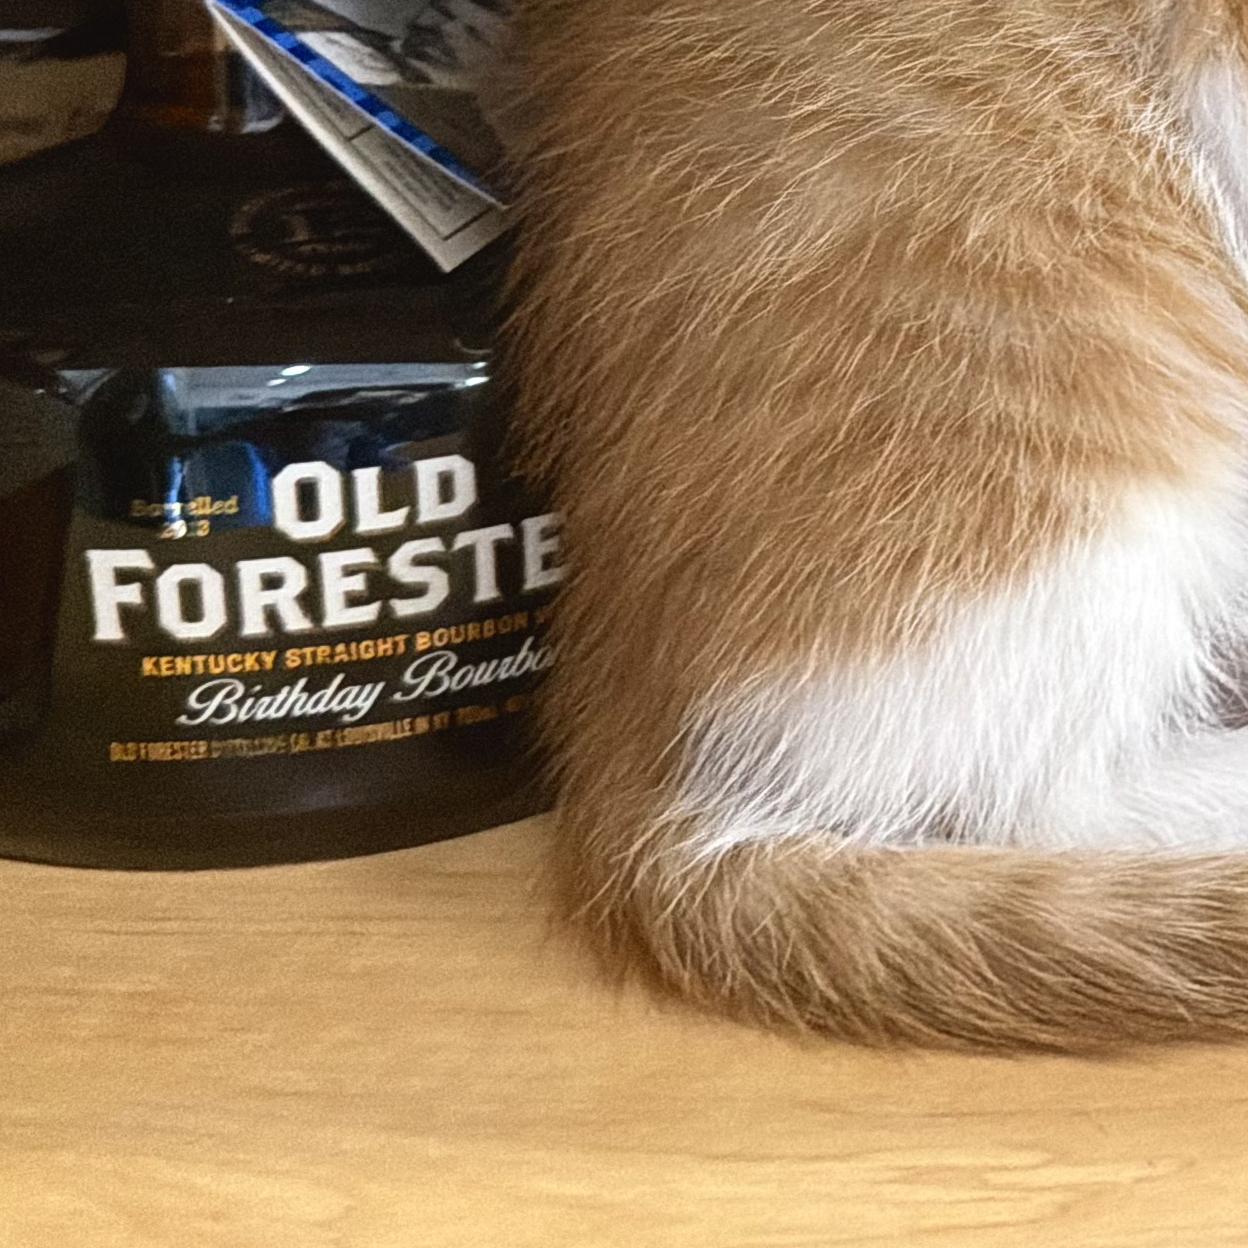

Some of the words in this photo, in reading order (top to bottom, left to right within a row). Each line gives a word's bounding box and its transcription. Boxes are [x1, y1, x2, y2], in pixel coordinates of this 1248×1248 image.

[272, 453, 478, 542] OLD
[141, 649, 276, 678] KENTUCKY
[284, 633, 408, 672] STRAIGHT
[415, 615, 531, 650] BOURBON
[175, 671, 387, 724] Birthday
